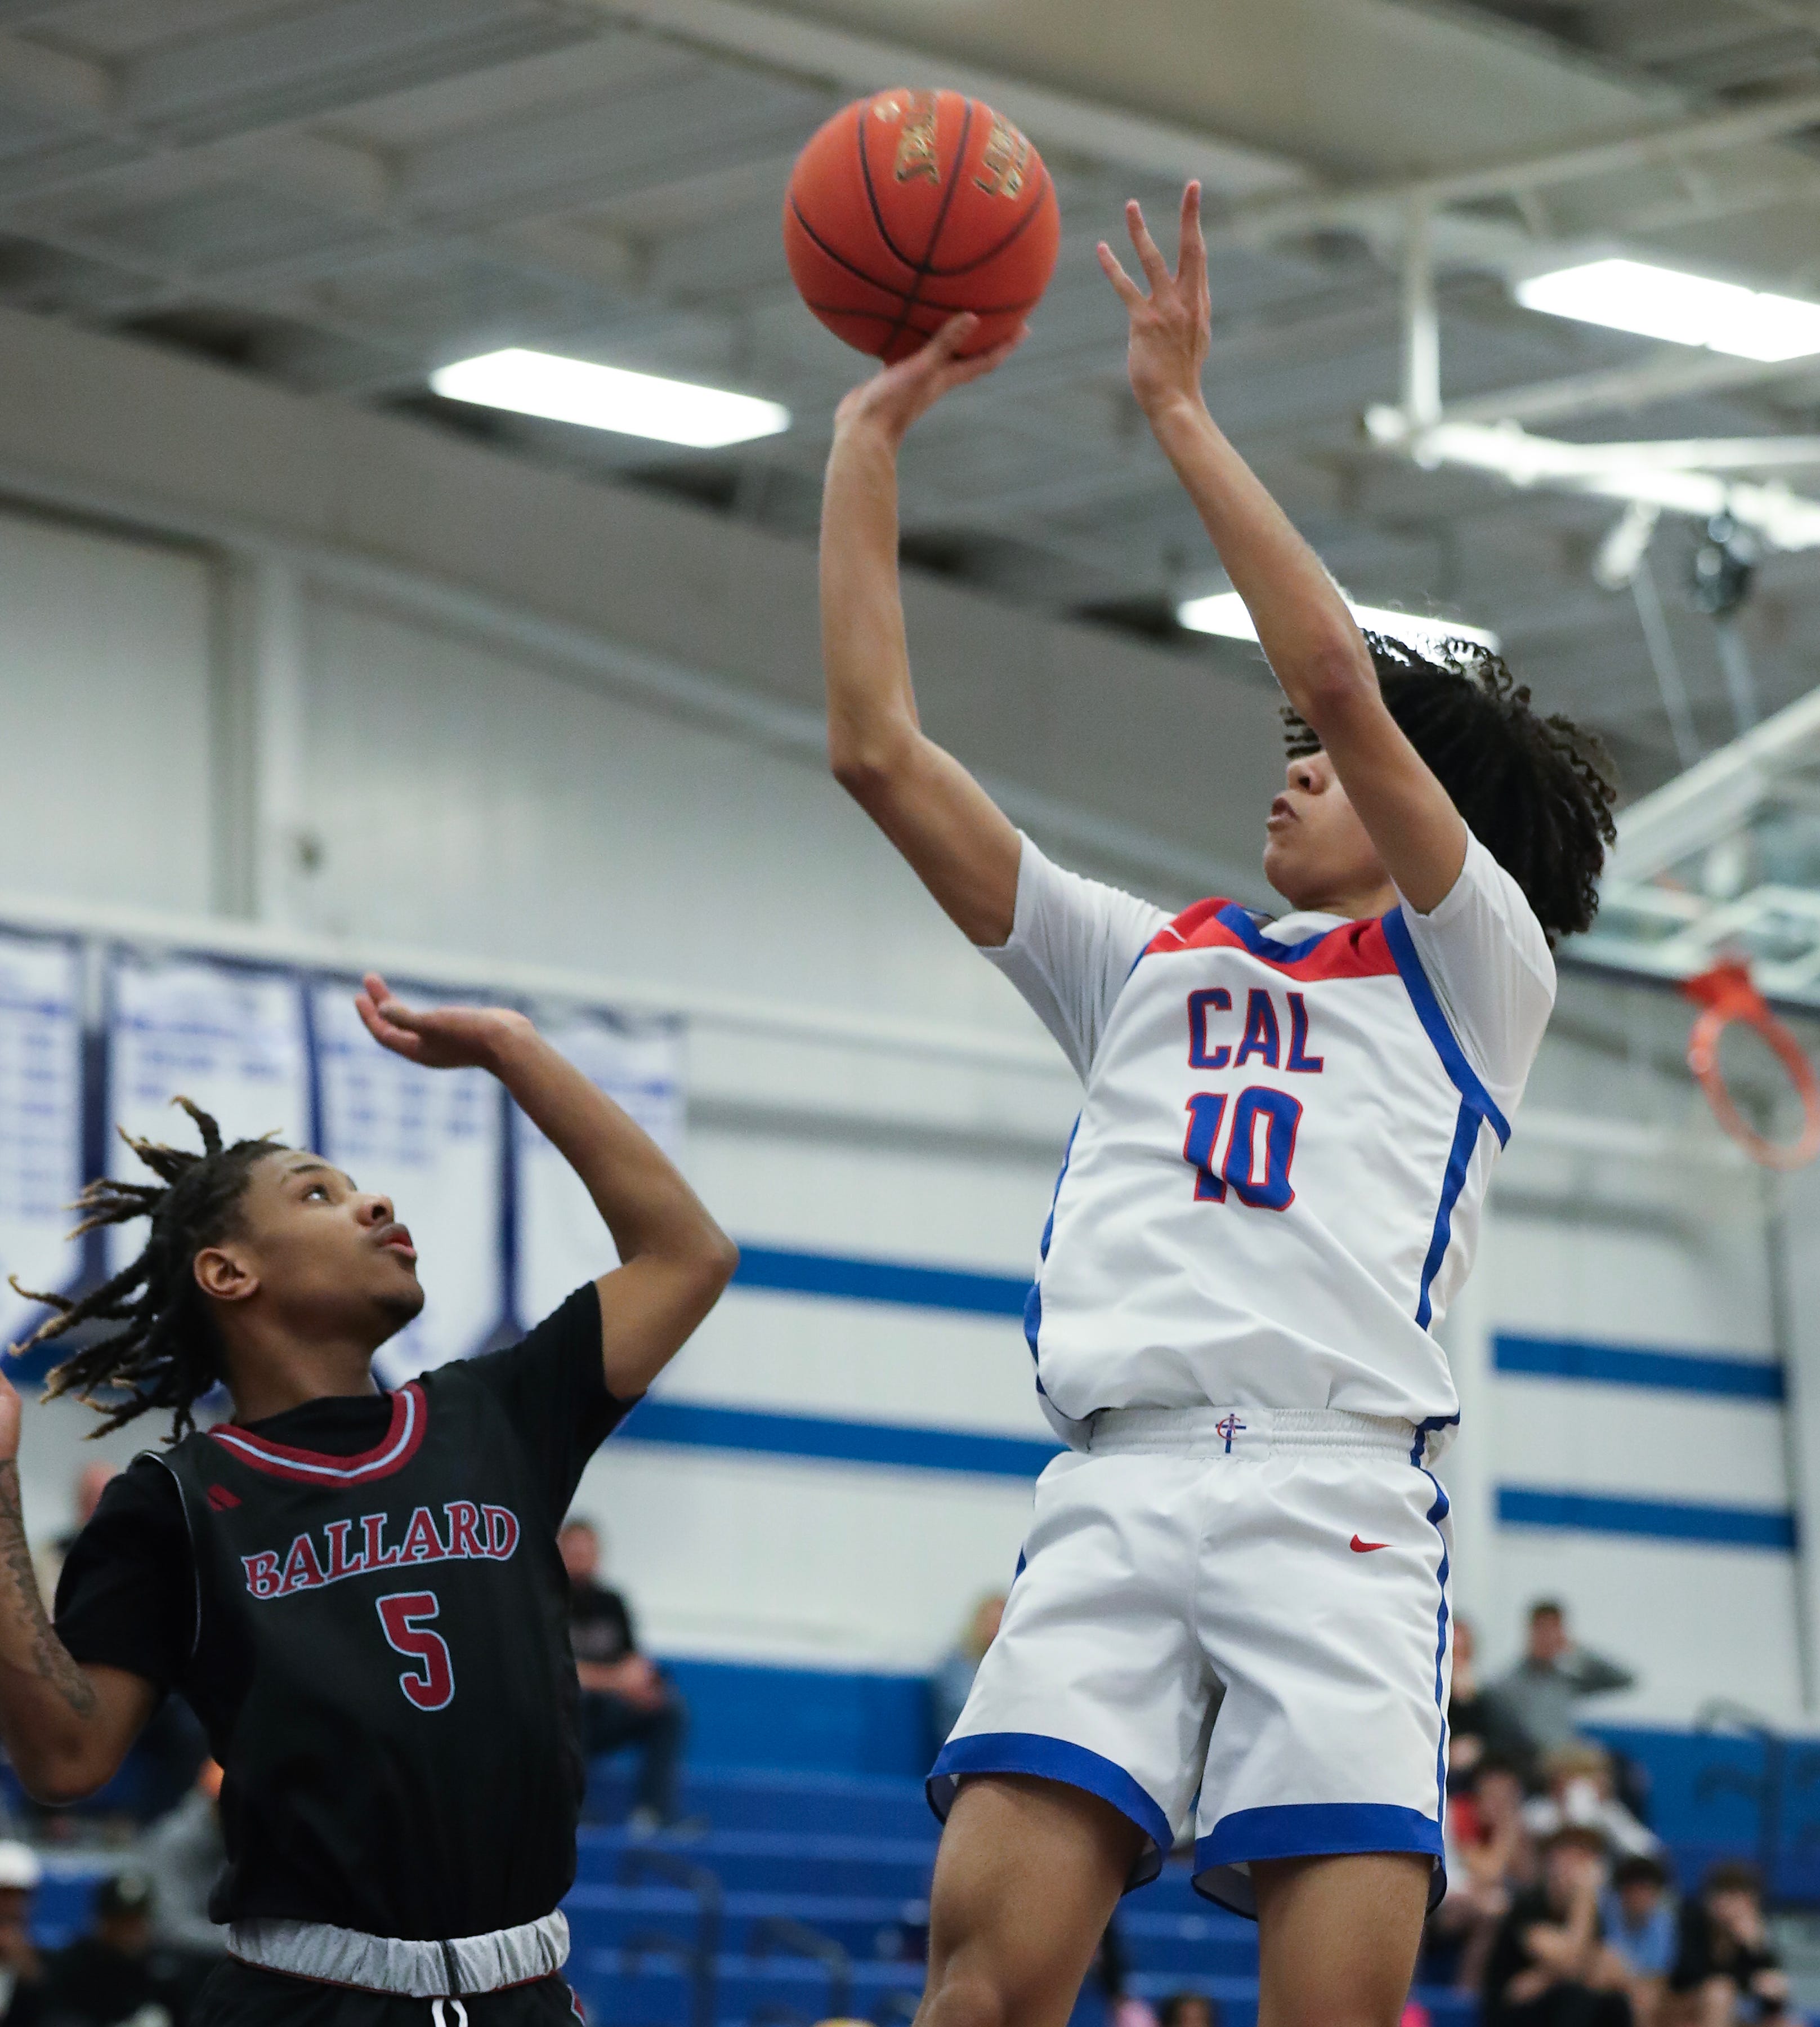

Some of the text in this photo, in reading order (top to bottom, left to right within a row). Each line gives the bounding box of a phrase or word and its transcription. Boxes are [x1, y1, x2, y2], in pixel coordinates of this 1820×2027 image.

[1187, 988, 1324, 1073] CAL
[1183, 1086, 1304, 1212] 10
[240, 1500, 520, 1600] BALLARD
[375, 1590, 455, 1711] 5
